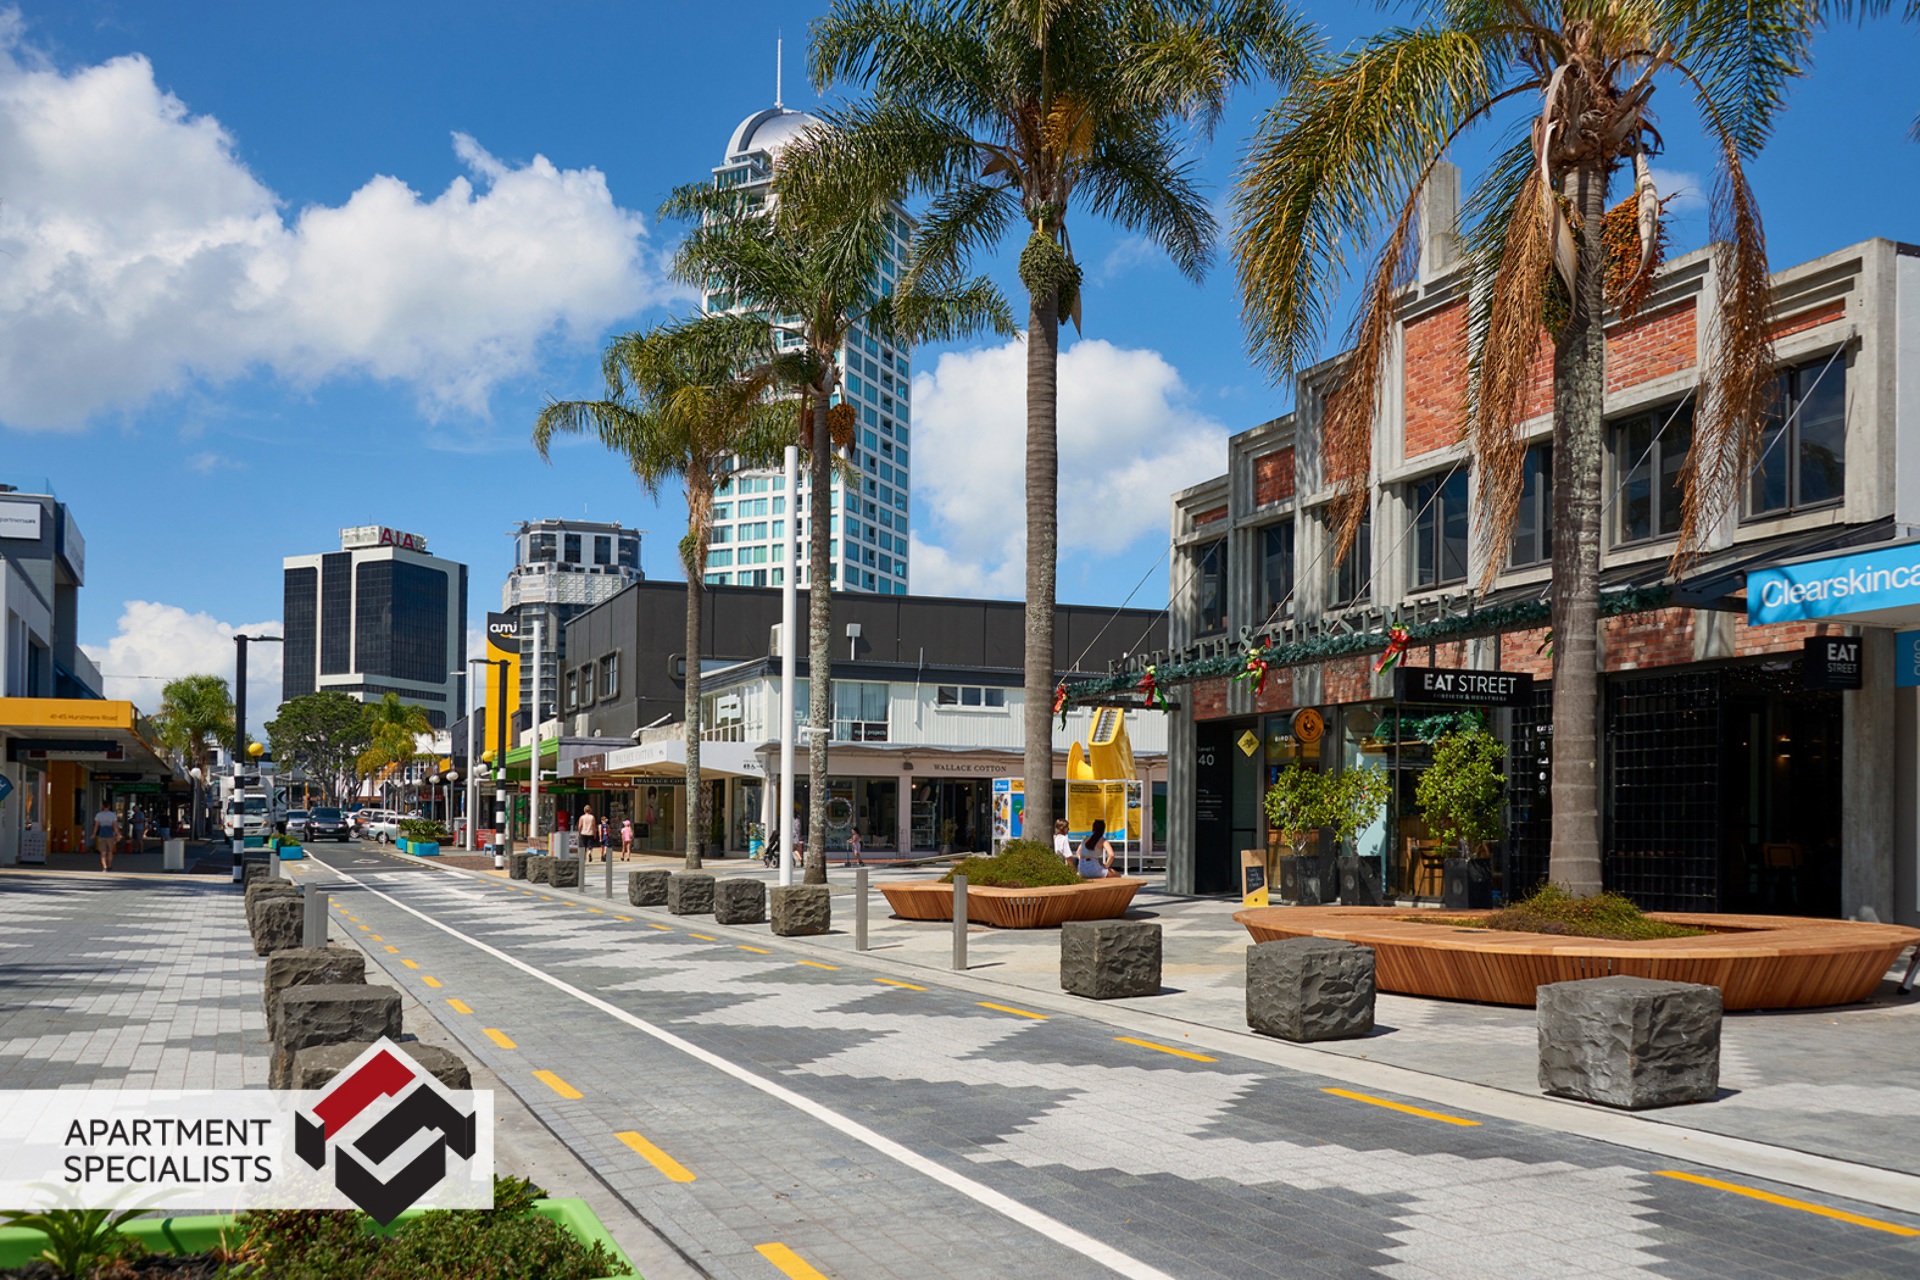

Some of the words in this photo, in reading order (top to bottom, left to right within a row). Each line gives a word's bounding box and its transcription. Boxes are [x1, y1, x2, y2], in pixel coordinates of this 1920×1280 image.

[380, 528, 415, 549] AIA
[490, 621, 518, 633] ami
[1827, 643, 1858, 661] EAT
[1827, 662, 1858, 674] STREET
[1424, 673, 1455, 691] EAT
[1458, 675, 1518, 694] STREET
[1198, 754, 1215, 766] 40
[933, 763, 973, 772] WALLACE
[973, 765, 1008, 773] COTTON
